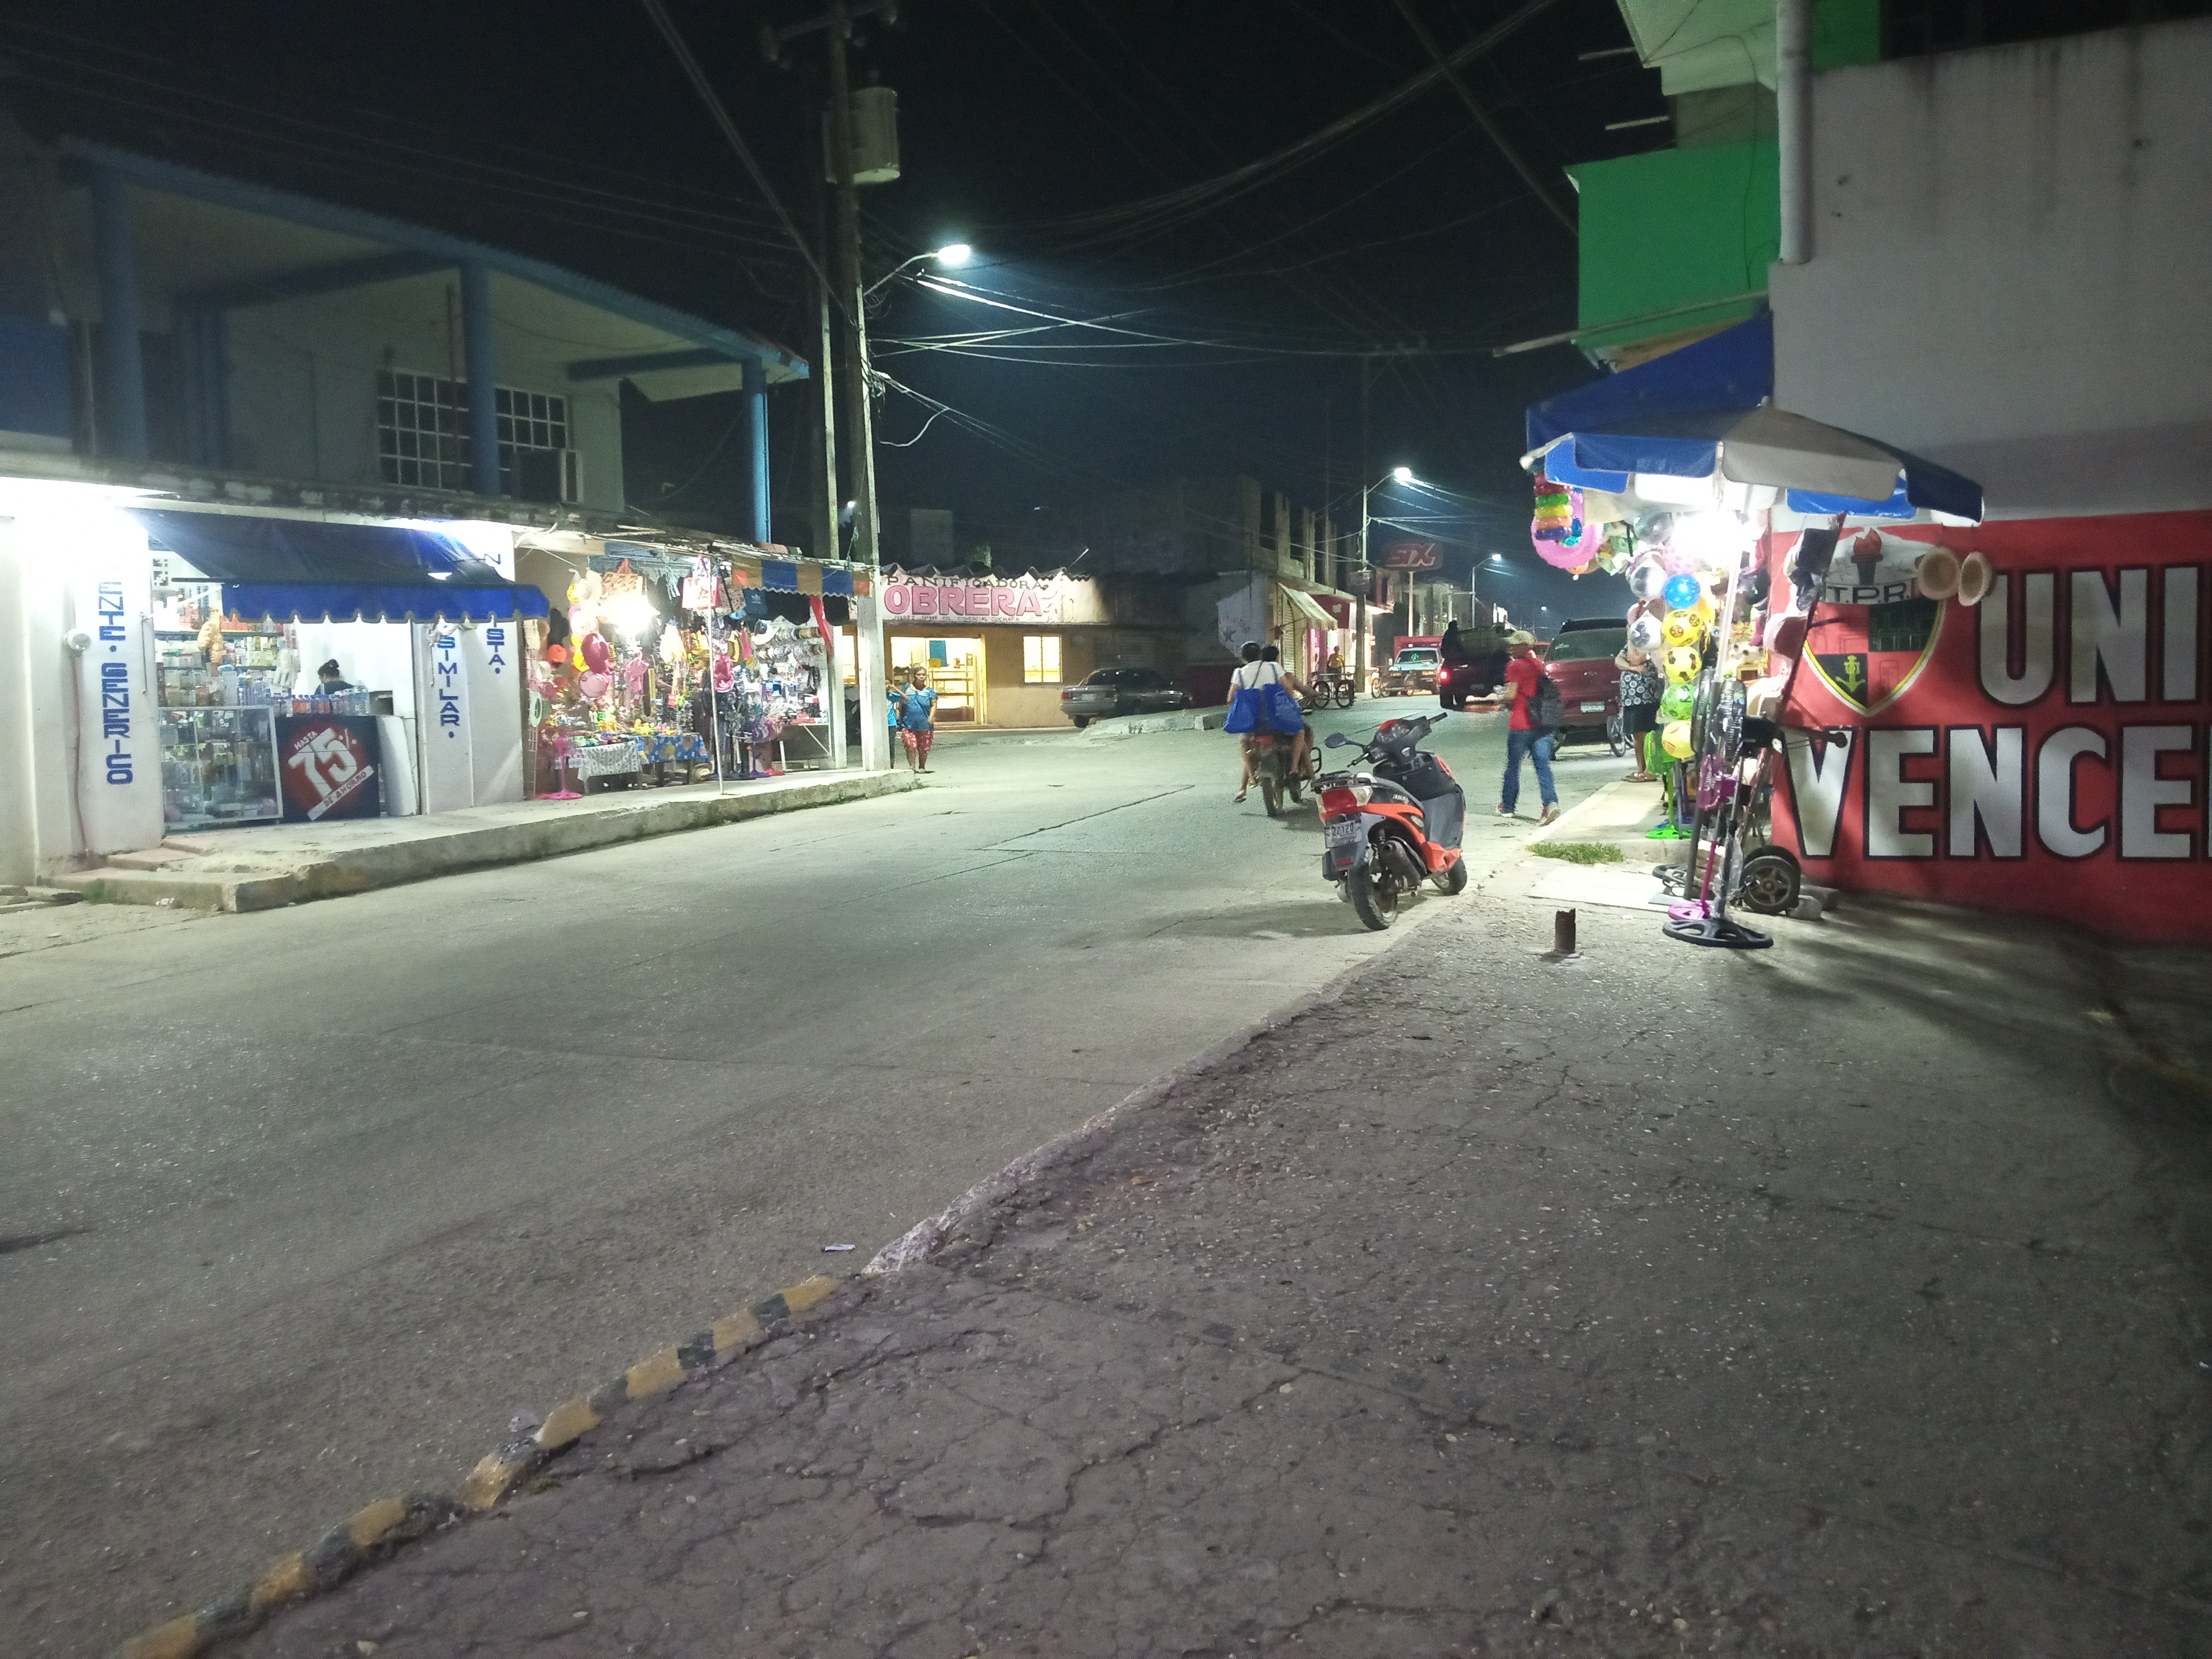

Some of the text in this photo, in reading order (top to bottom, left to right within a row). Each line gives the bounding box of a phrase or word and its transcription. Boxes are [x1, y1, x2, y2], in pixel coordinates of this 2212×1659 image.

[1386, 543, 1436, 567] SIX
[887, 577, 1042, 589] PANIFICADORA
[884, 585, 1042, 617] OBRERA
[1978, 566, 2199, 707] UNI
[101, 662, 133, 785] GENERICO
[294, 731, 318, 750] HASTA
[1782, 725, 2212, 861] VENCE
